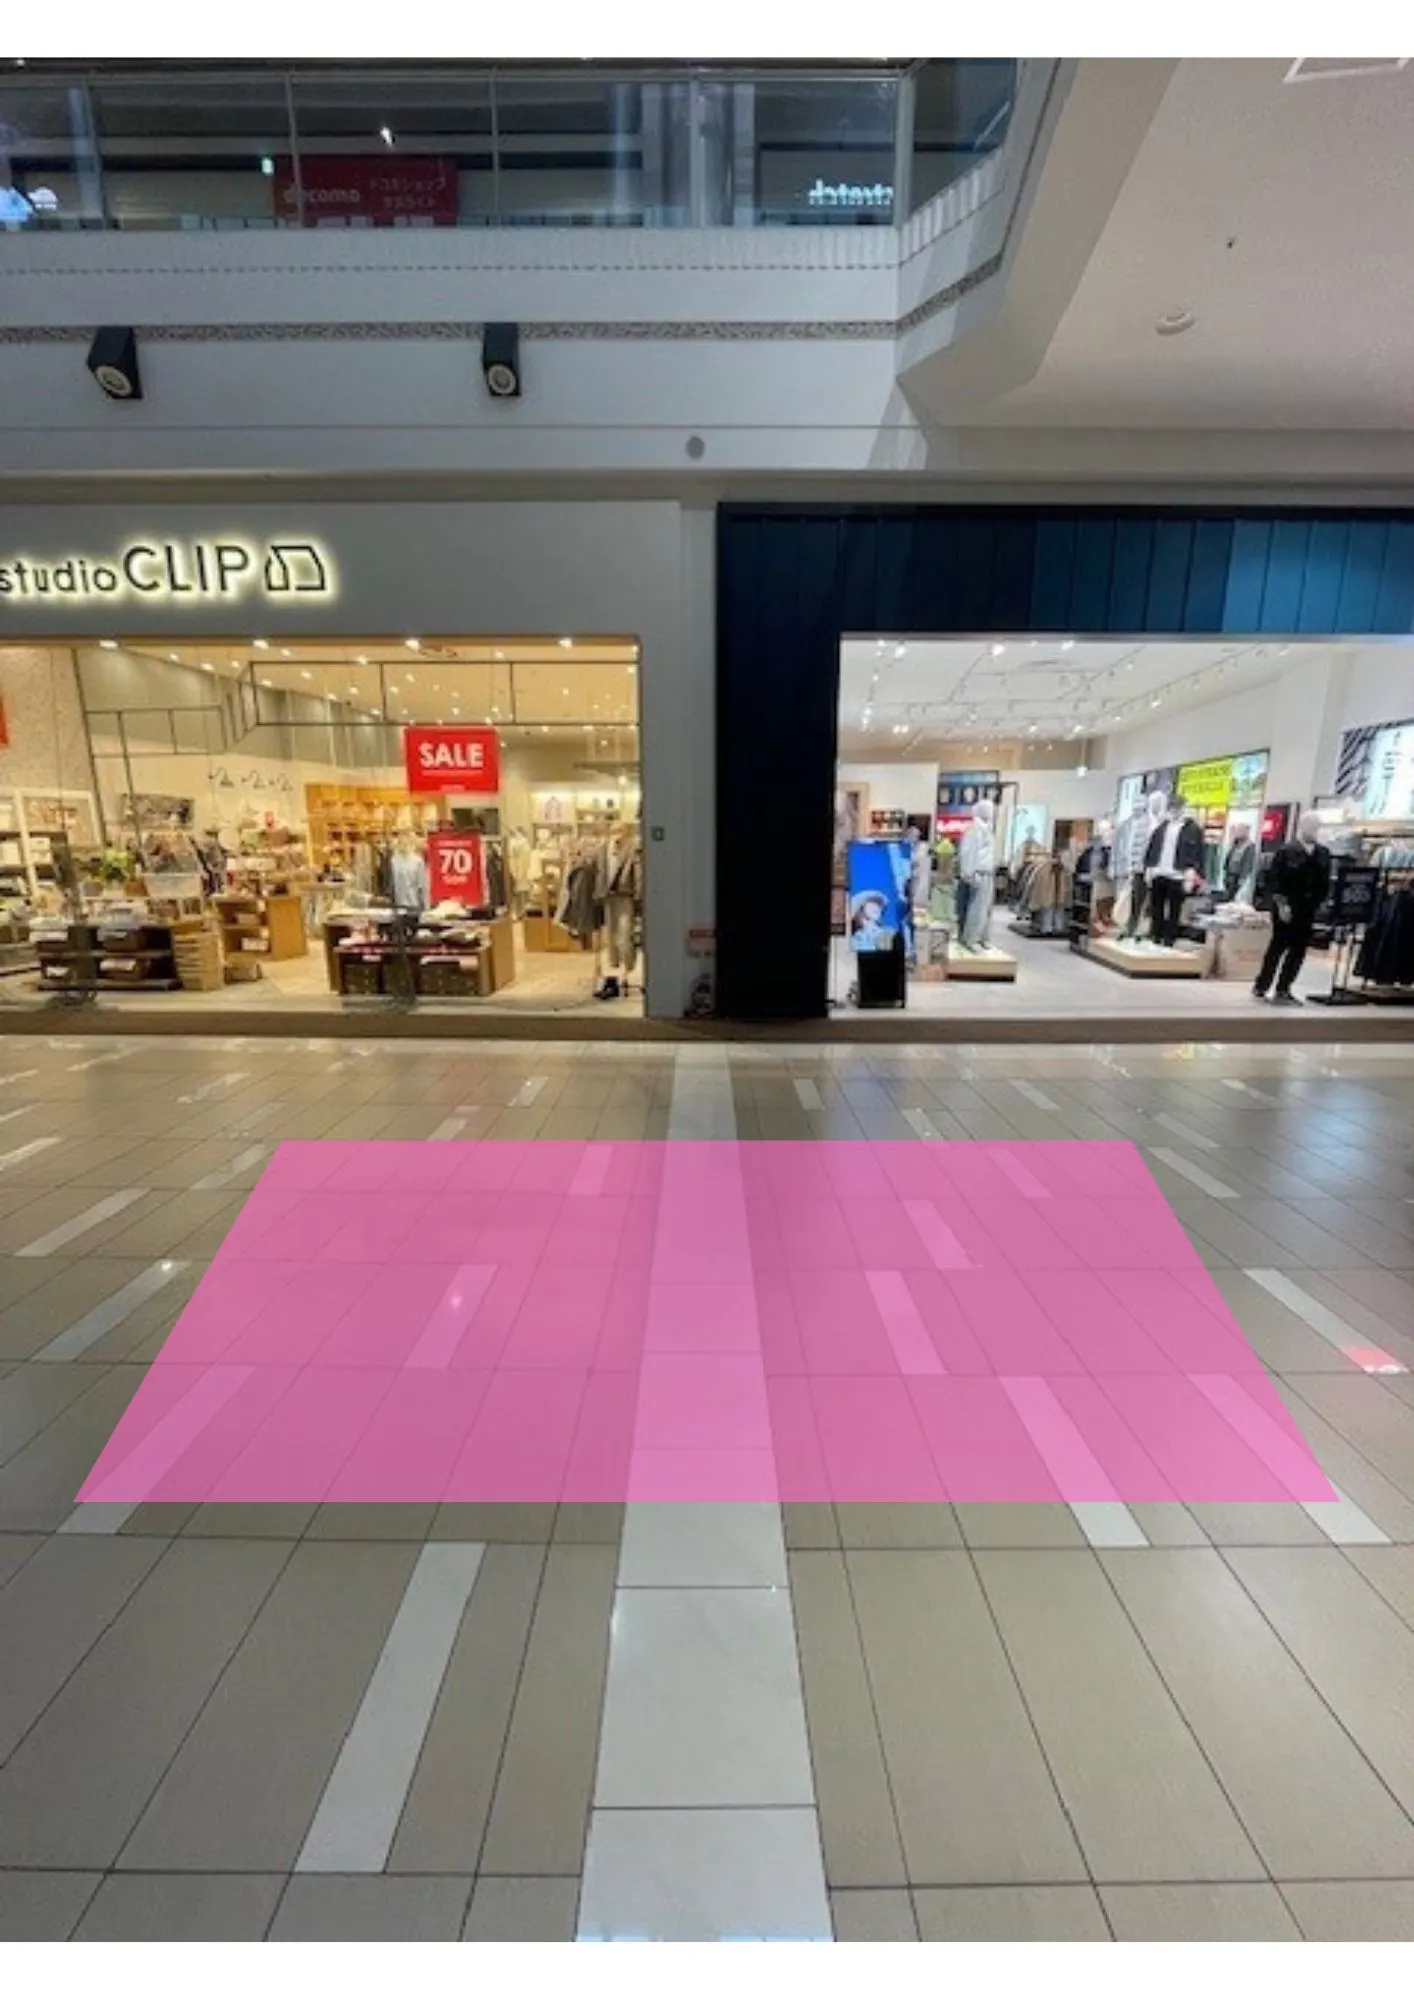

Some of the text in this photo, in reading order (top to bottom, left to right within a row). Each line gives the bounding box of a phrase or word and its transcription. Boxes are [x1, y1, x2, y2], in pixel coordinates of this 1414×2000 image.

[0, 545, 249, 593] studio CLIP
[420, 743, 484, 768] SALE
[438, 849, 473, 874] 70
